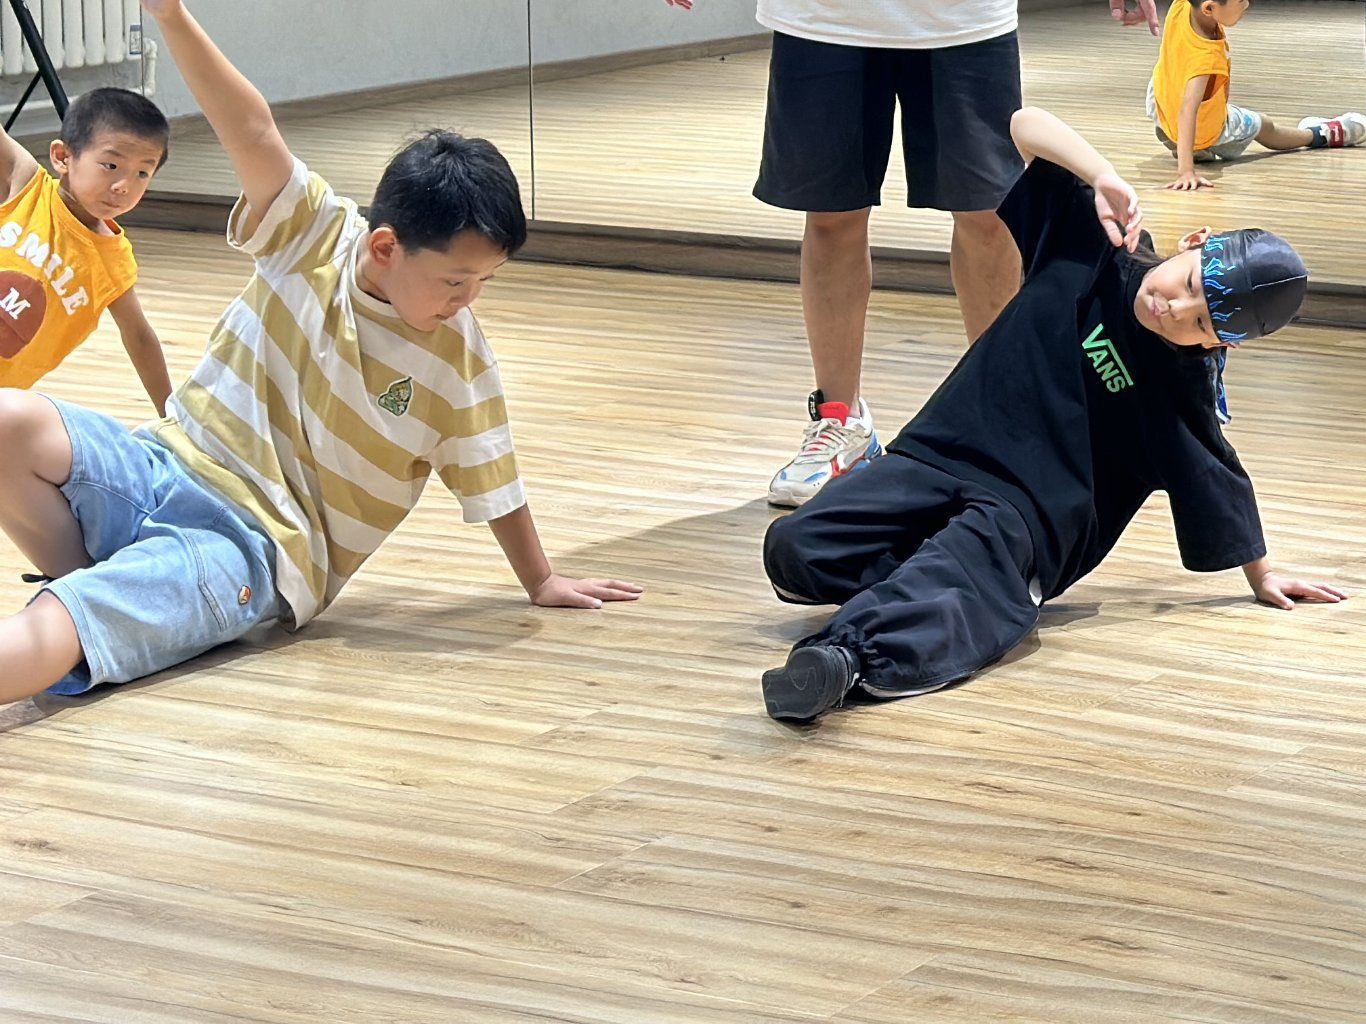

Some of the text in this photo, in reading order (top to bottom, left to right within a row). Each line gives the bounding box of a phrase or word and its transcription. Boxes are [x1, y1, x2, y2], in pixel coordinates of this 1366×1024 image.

[0, 221, 89, 316] SMILE
[0, 287, 31, 320] M
[1082, 323, 1134, 394] VANS
